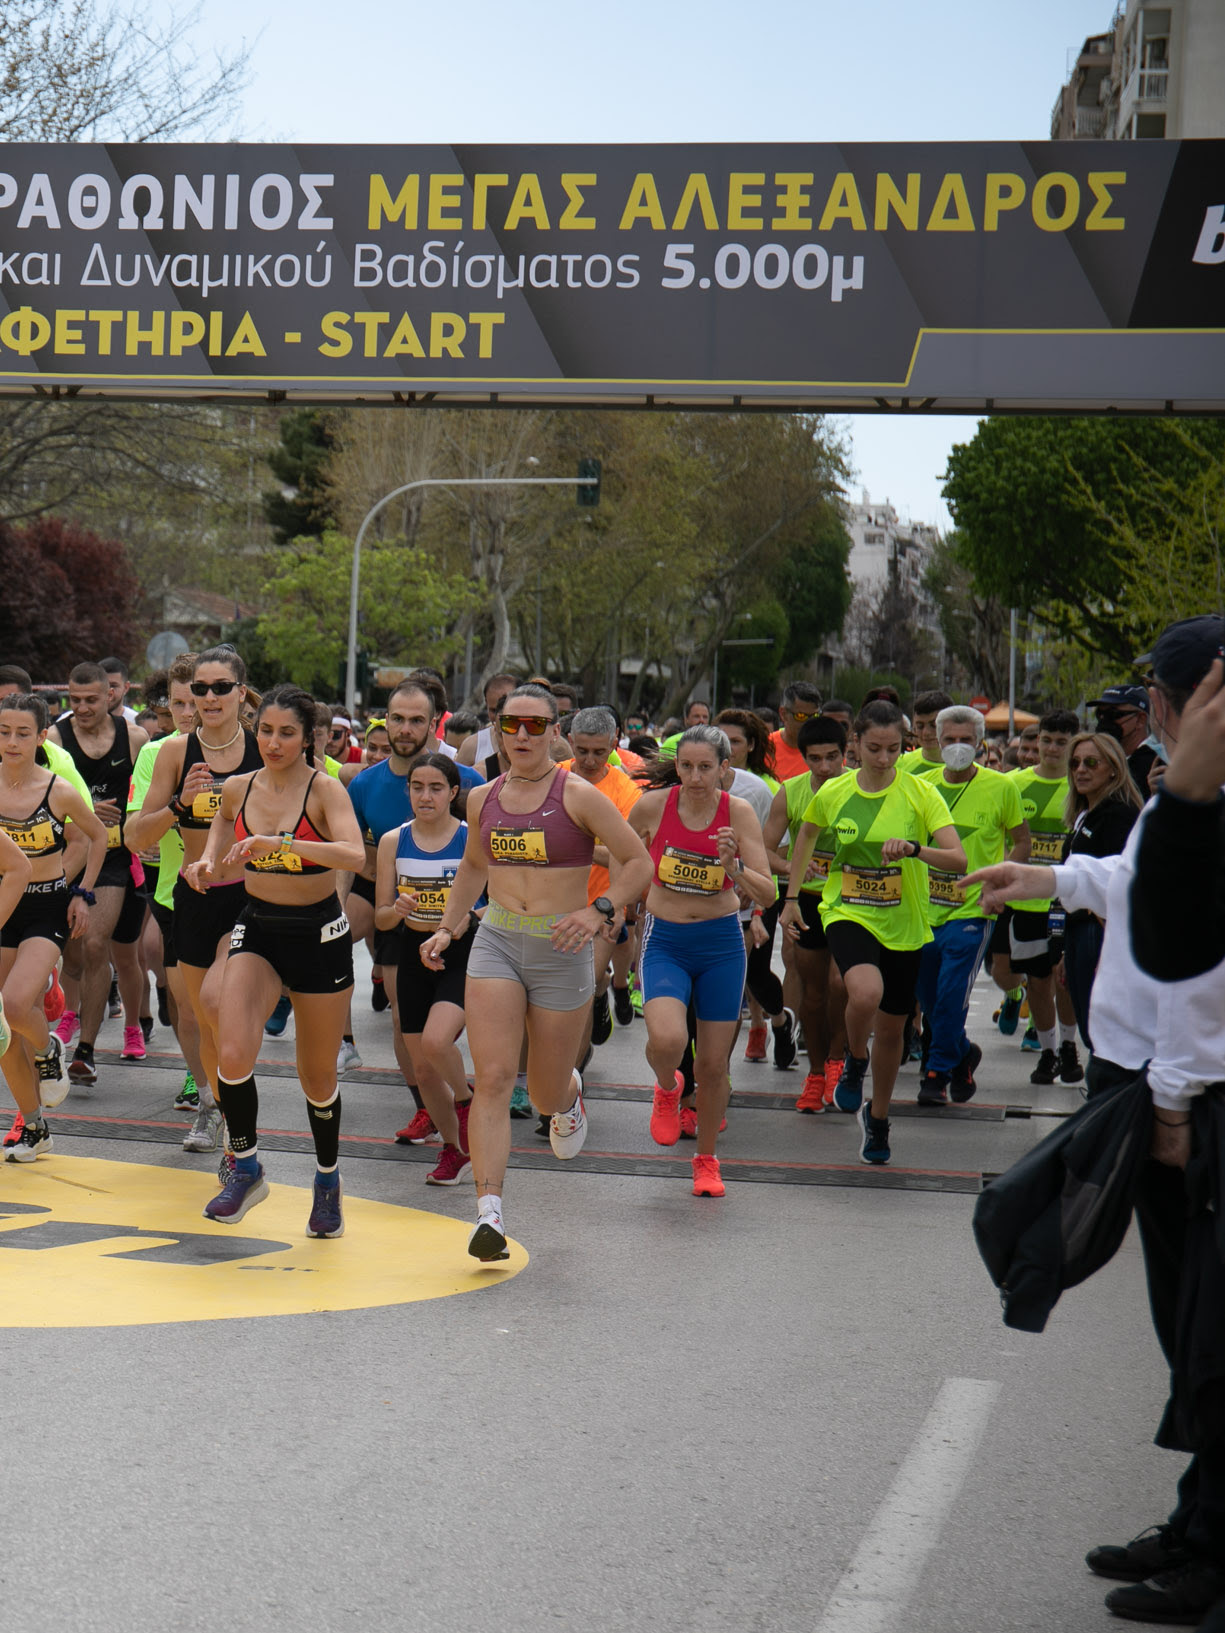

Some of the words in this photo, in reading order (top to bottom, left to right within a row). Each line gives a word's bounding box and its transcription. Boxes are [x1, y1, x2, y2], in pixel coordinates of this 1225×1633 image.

[367, 173, 597, 231] ΜΕΓΑΣ
[619, 172, 1127, 232] ΑΛΕΞΑΝΔΡΟΣ
[80, 240, 332, 297] Δυναμικού
[353, 240, 641, 298] Βαδίσματος
[661, 243, 865, 302] 5.000μ
[318, 311, 506, 358] START
[491, 838, 527, 851] 5006
[1032, 840, 1058, 853] 8717
[673, 864, 708, 881] 5008
[855, 879, 887, 892] 5024
